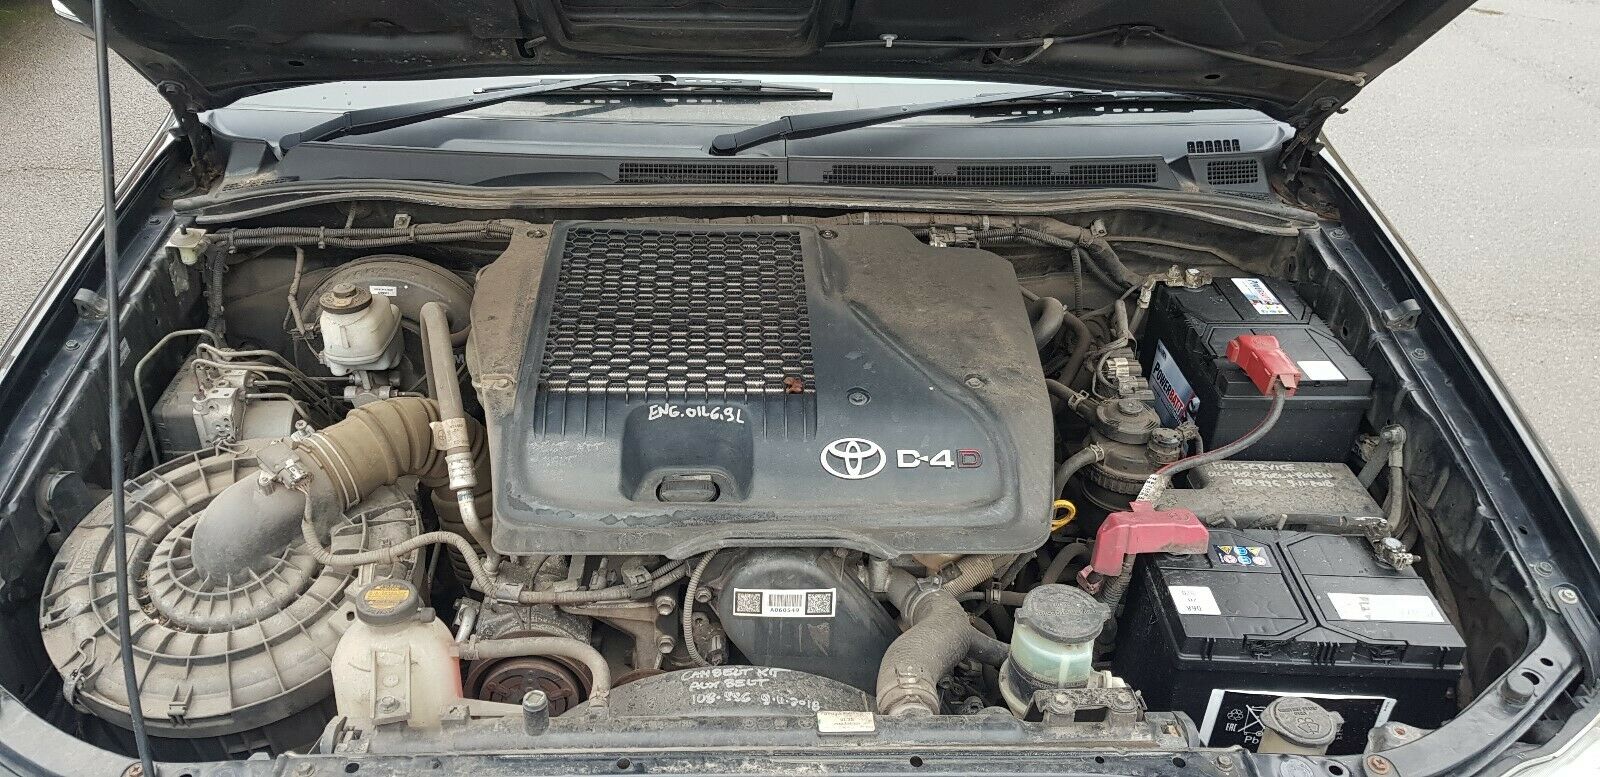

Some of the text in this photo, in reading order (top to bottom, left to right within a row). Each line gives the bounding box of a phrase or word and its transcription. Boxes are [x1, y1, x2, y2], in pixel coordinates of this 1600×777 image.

[1153, 361, 1185, 415] POWERBATT
[897, 449, 983, 469] D-4D
[689, 678, 770, 692] AUX BELT
[1244, 735, 1259, 744] Pb
